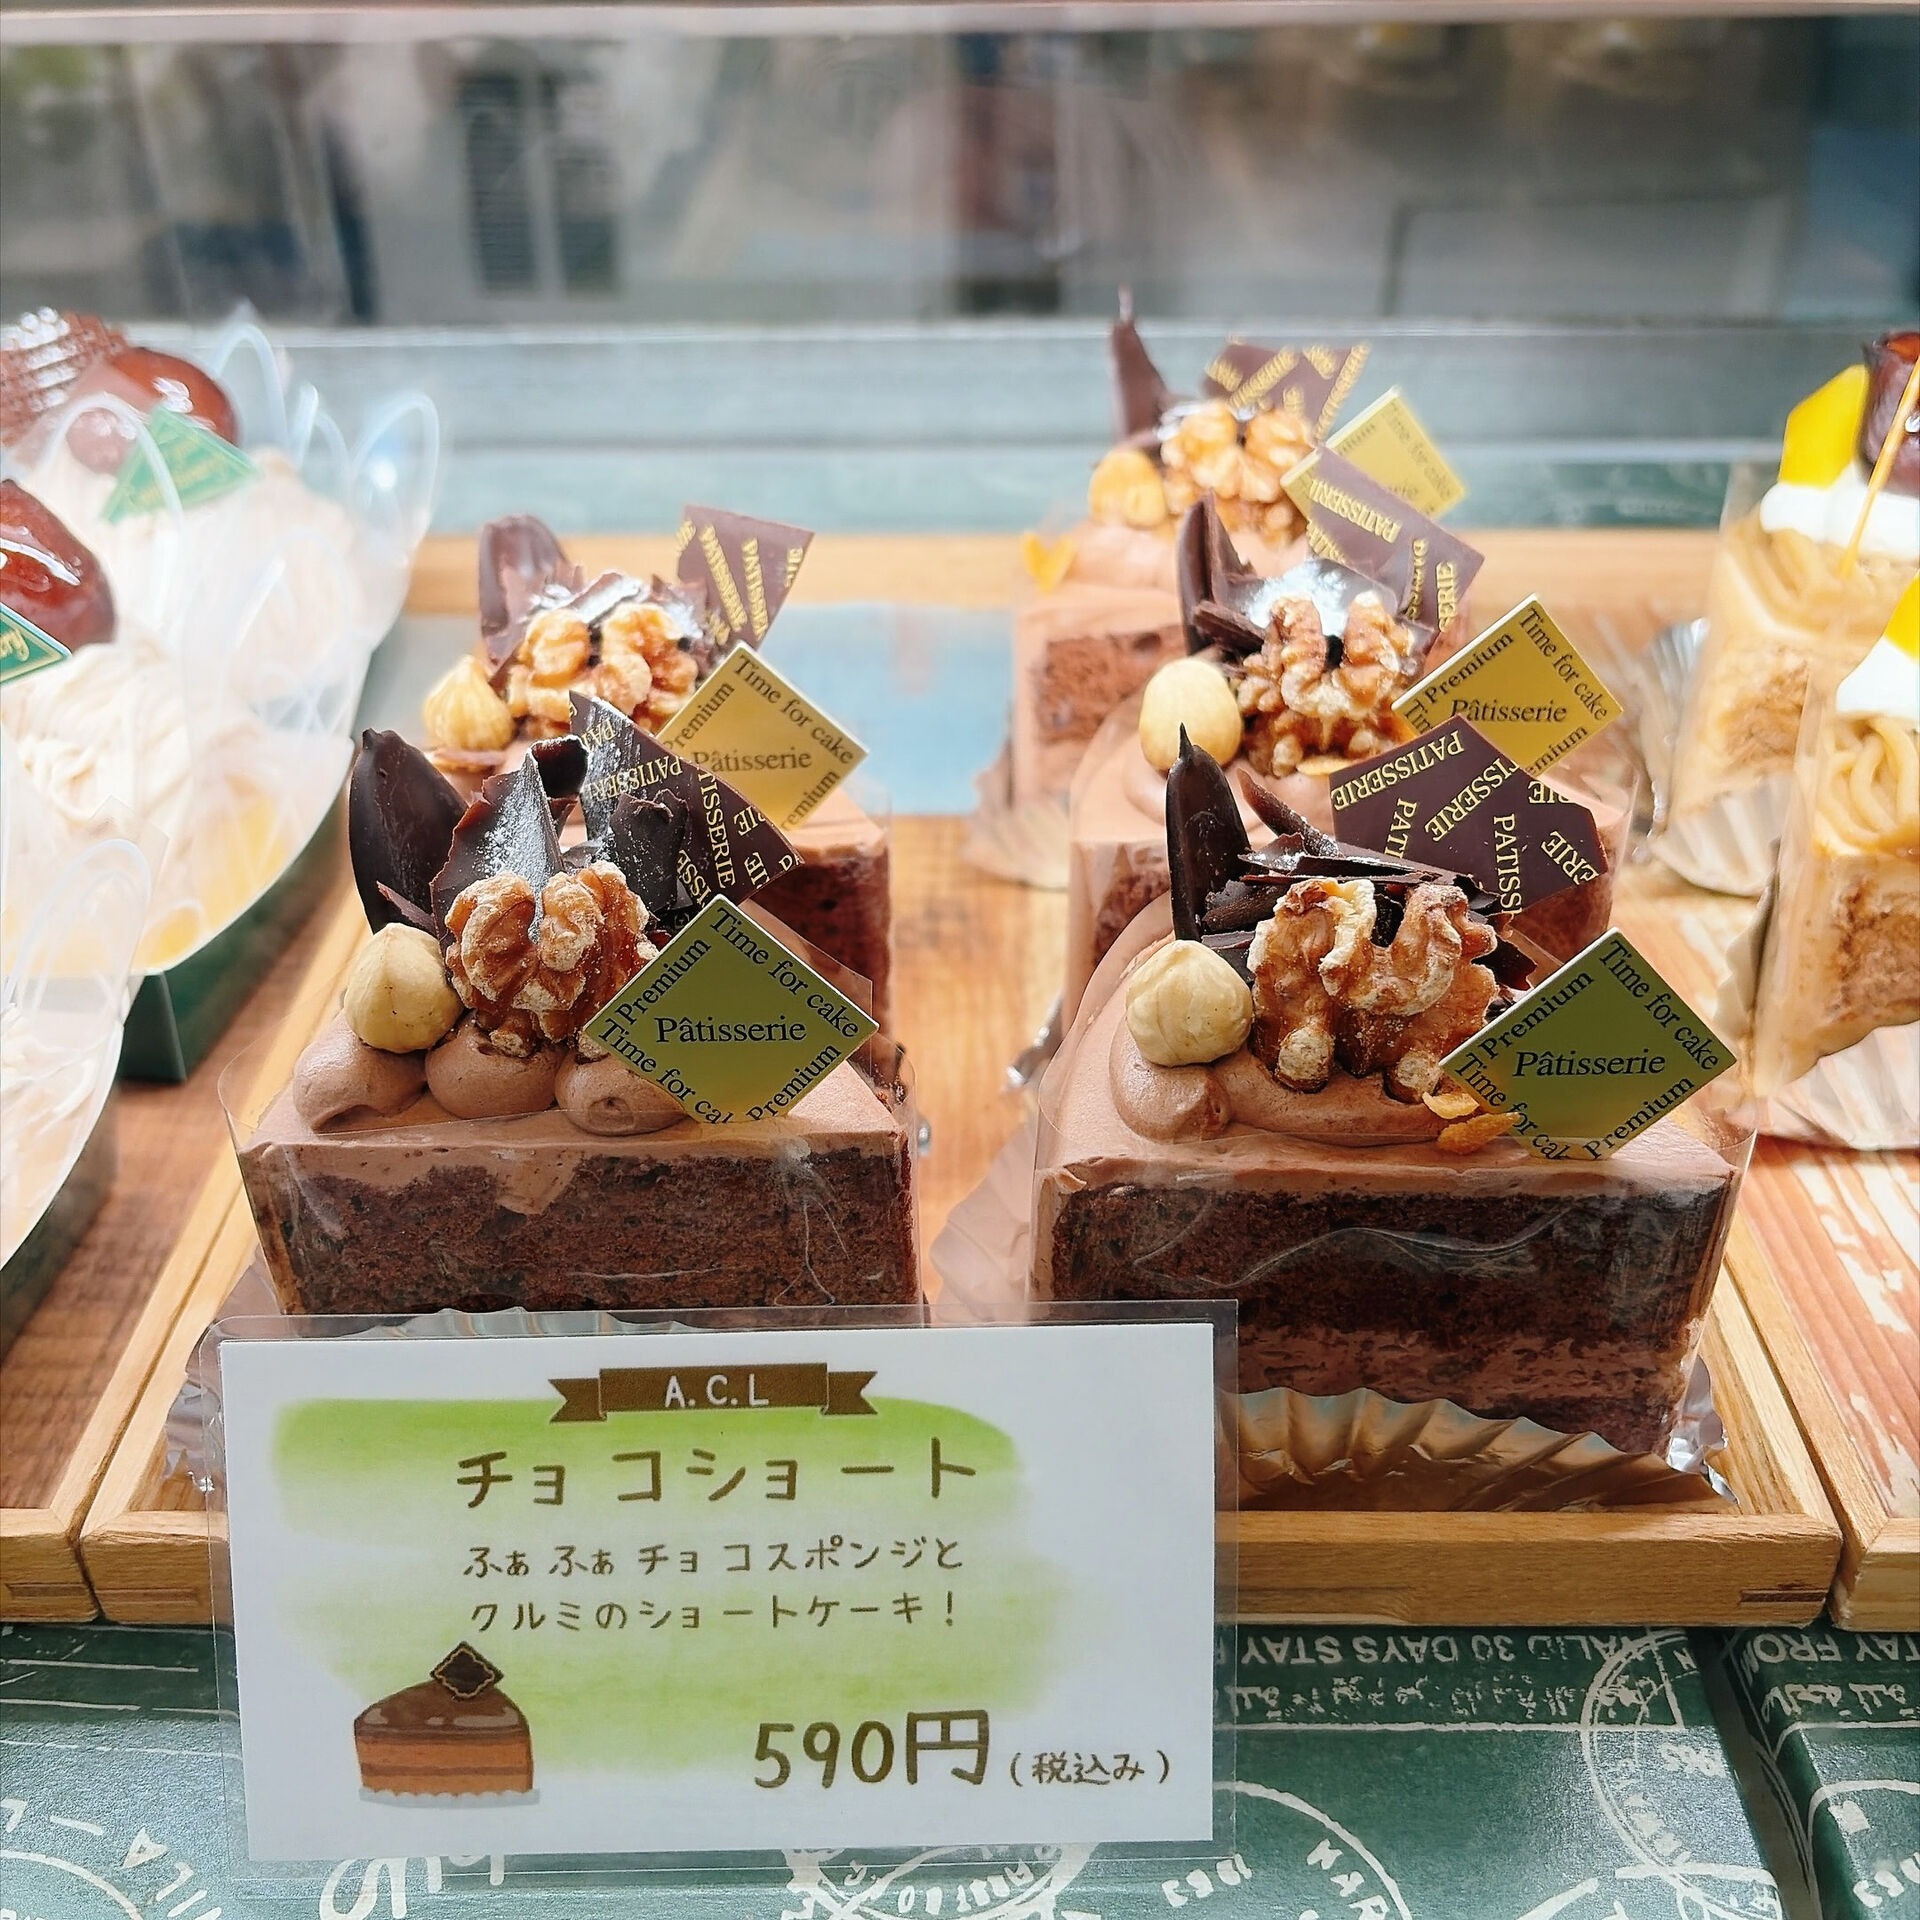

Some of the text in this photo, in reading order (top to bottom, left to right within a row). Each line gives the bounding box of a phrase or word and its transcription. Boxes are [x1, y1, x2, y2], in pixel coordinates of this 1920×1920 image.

[1425, 631, 1515, 705] Premium
[1518, 607, 1608, 721] Time for cake
[732, 653, 855, 765] Time for cake
[1449, 699, 1568, 723] Pâtisserie
[692, 747, 813, 774] Pâtisserie
[1329, 729, 1465, 811] PATISSERIE
[615, 938, 712, 1026] Premium
[709, 905, 860, 1039] Time for cake
[1599, 938, 1720, 1071] Time for cake
[654, 1014, 808, 1043] Pâtisserie
[1477, 969, 1595, 1061] Premium
[597, 1017, 658, 1074] Time
[655, 1068, 697, 1102] for
[745, 1044, 843, 1122] Premium
[1454, 1052, 1508, 1108] Time
[1508, 1102, 1538, 1137] for
[1512, 1048, 1666, 1078] Pâtisserie
[1582, 1077, 1695, 1161] Premium
[664, 1373, 770, 1408] A.C.L
[456, 1436, 977, 1509] チョコショート
[1240, 1633, 1344, 1666] STAY
[1351, 1633, 1460, 1665] DAYS
[752, 1709, 1172, 1789] 590円 (税込み)
